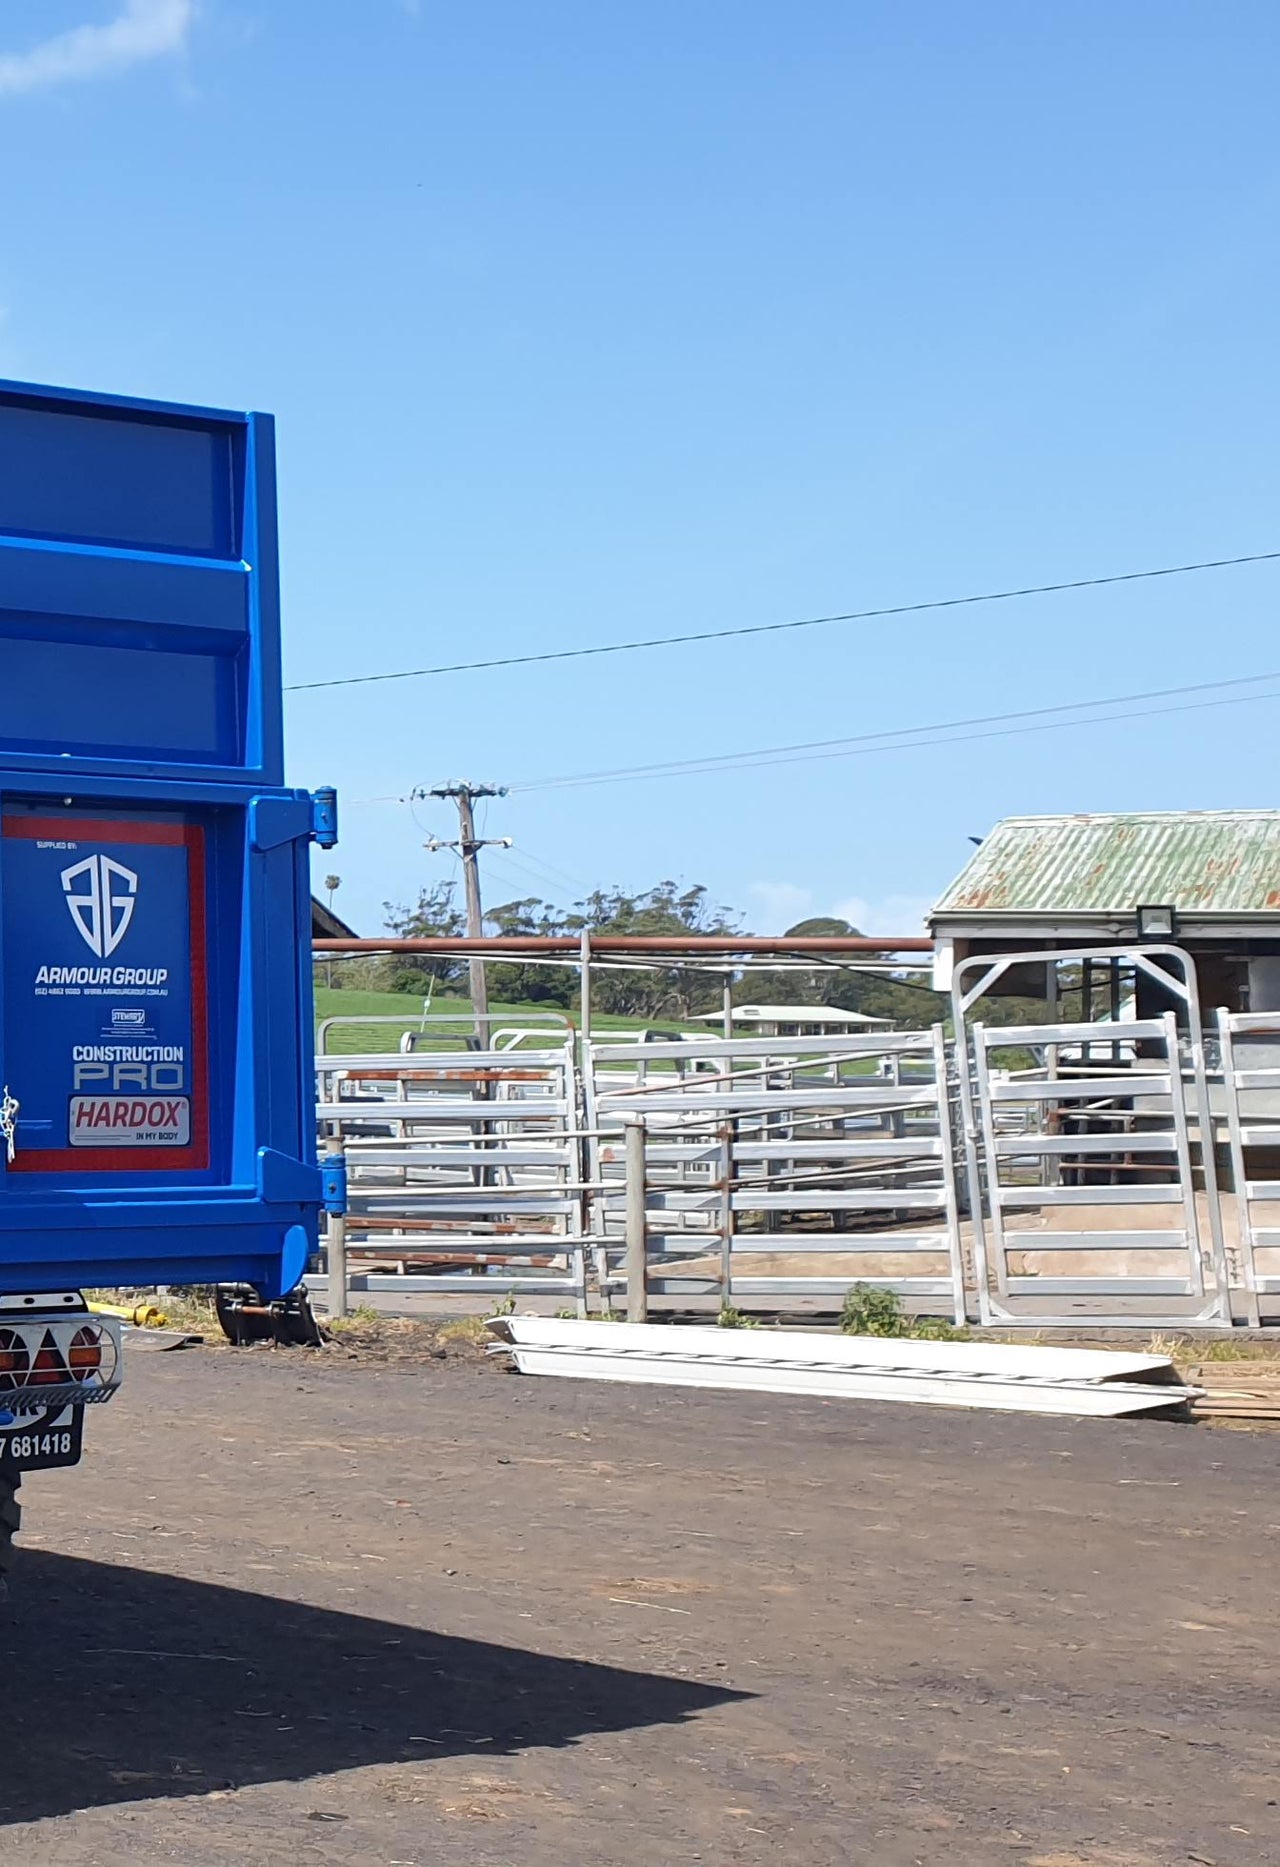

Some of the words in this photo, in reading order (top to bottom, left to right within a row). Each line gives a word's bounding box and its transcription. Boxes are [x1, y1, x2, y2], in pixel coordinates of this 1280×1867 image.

[35, 965, 112, 984] ARMOUR
[112, 966, 168, 985] GROUP
[72, 1045, 184, 1062] CONSTRUCTION
[73, 1062, 184, 1090] PRO
[75, 1101, 181, 1128] HARDOX
[136, 1131, 145, 1141] IN
[145, 1131, 157, 1141] MY
[158, 1131, 179, 1141] BODY
[11, 1432, 72, 1458] 681418
